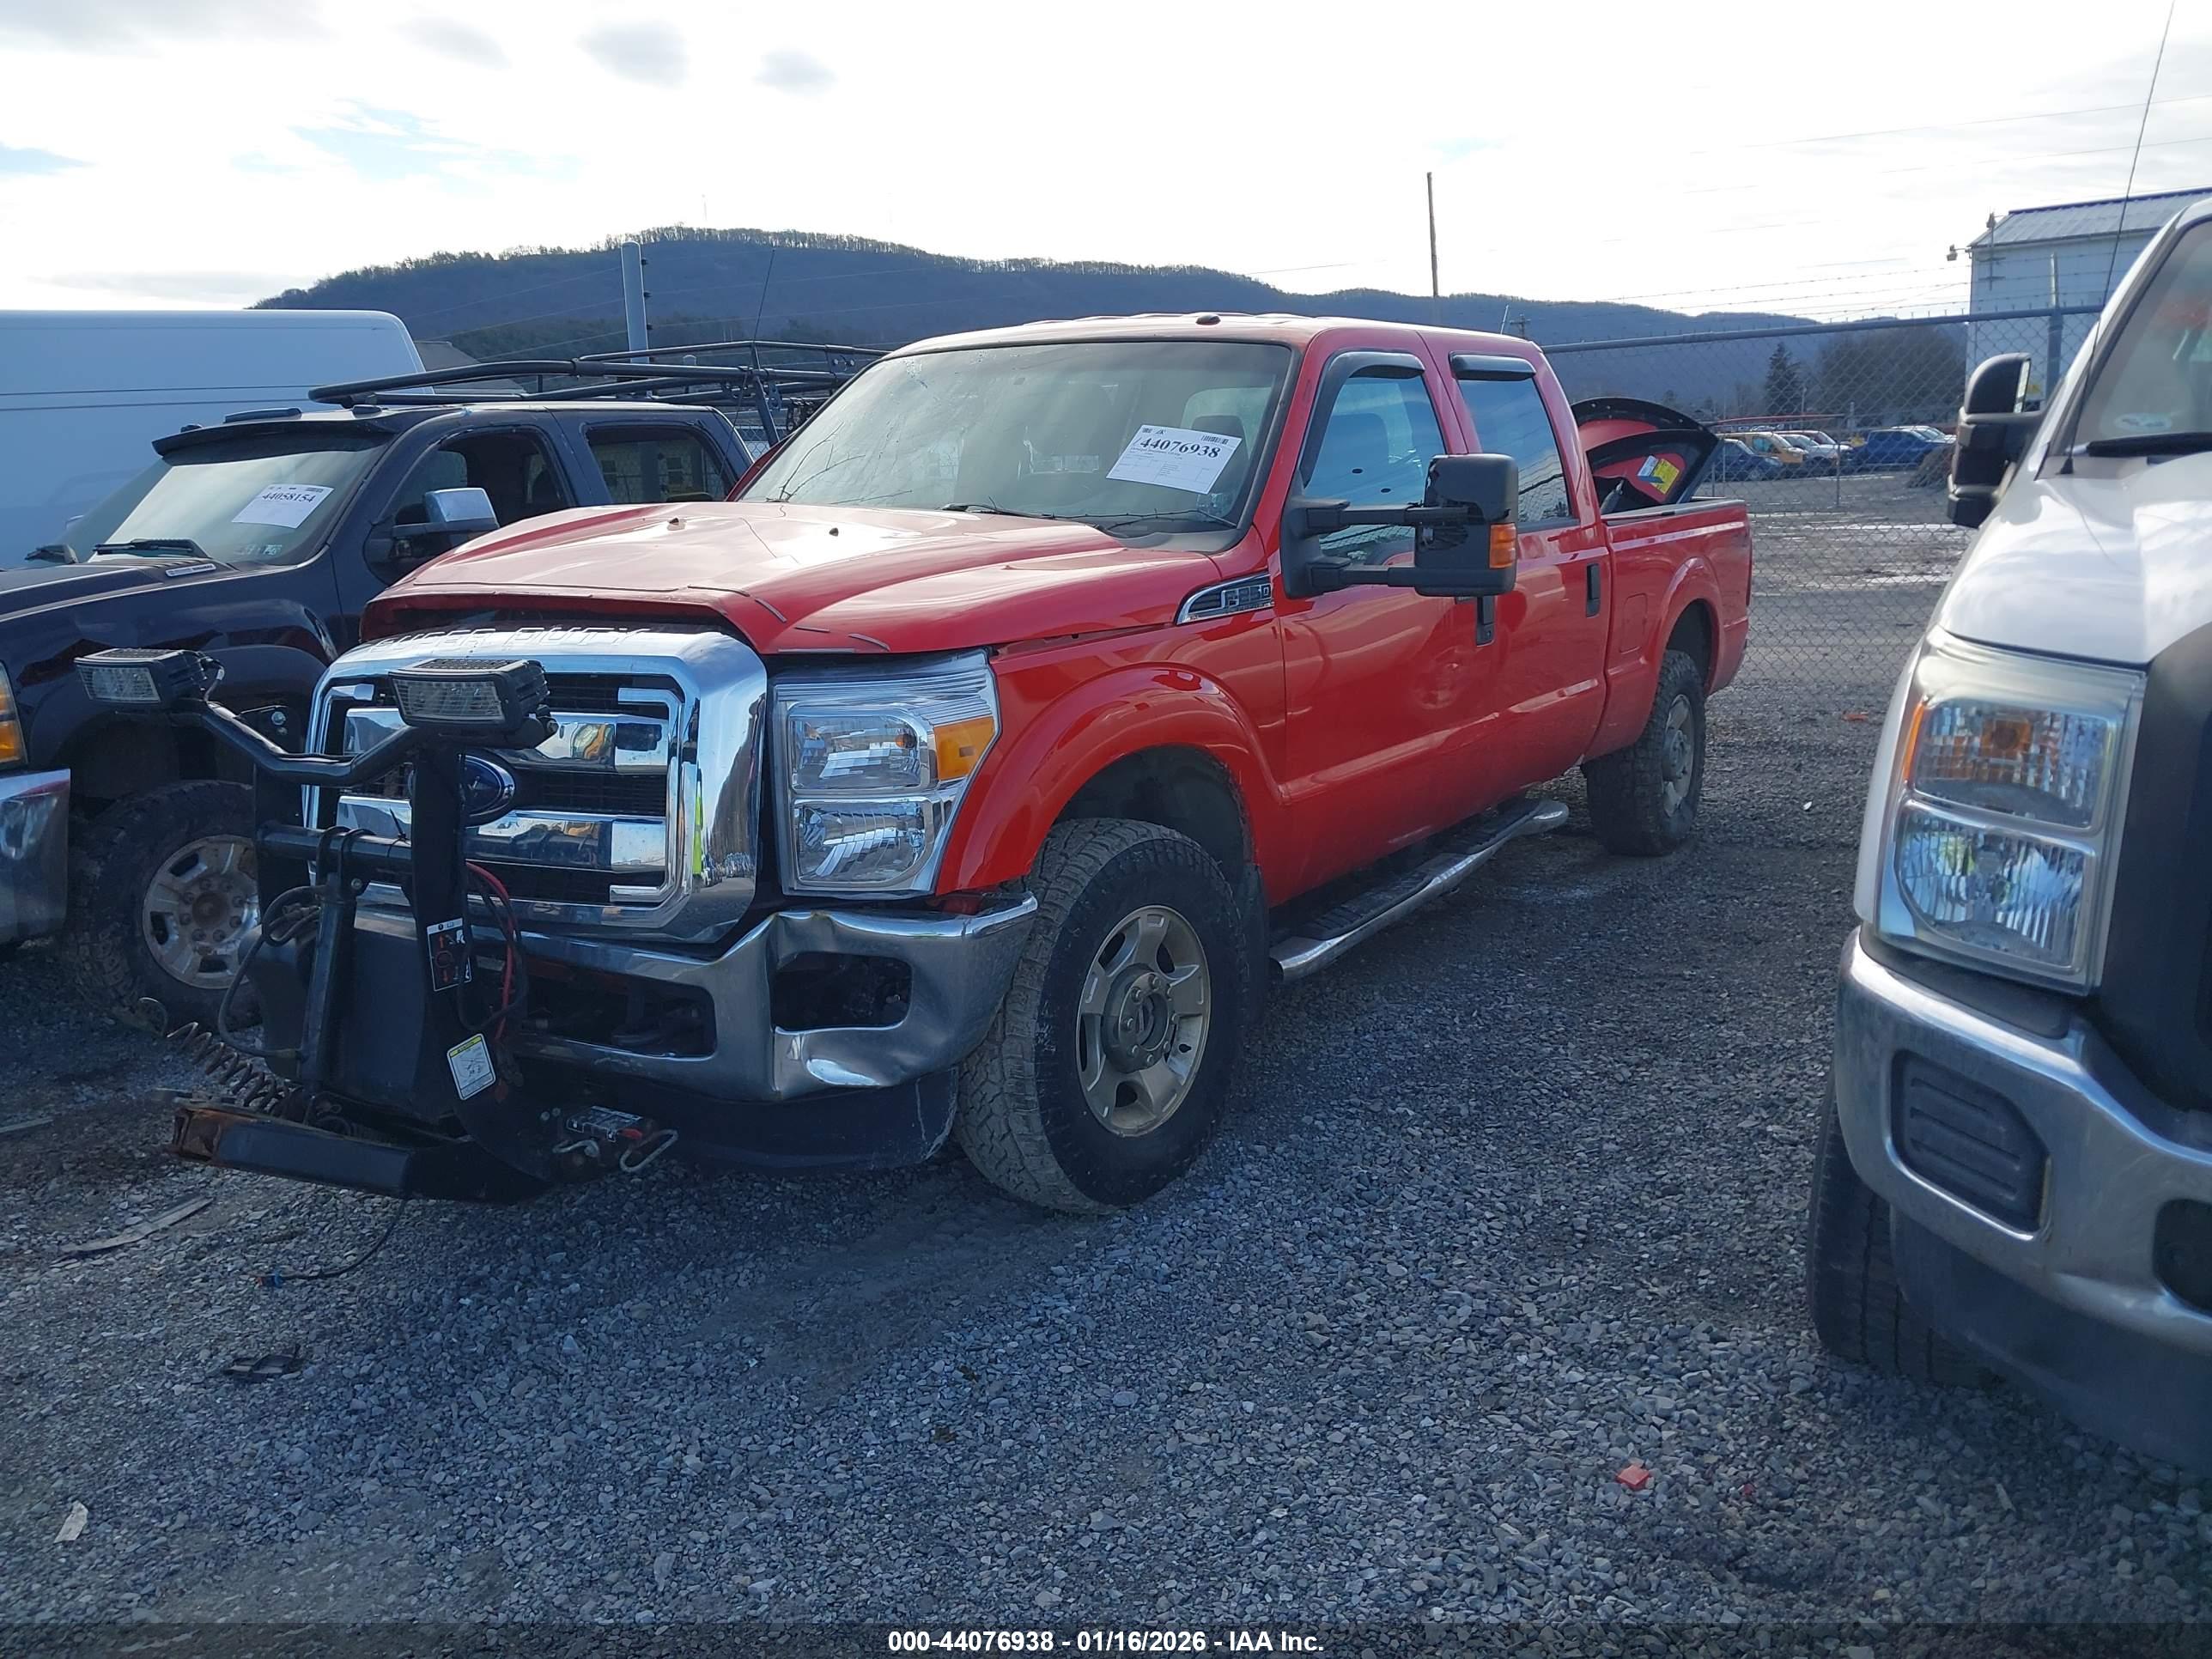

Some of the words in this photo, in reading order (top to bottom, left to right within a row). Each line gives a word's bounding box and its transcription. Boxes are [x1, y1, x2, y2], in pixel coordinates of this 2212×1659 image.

[1139, 437, 1221, 459] 44076938
[262, 491, 316, 503] 44058154
[370, 629, 496, 653] SUPER
[503, 627, 651, 650] DUTY
